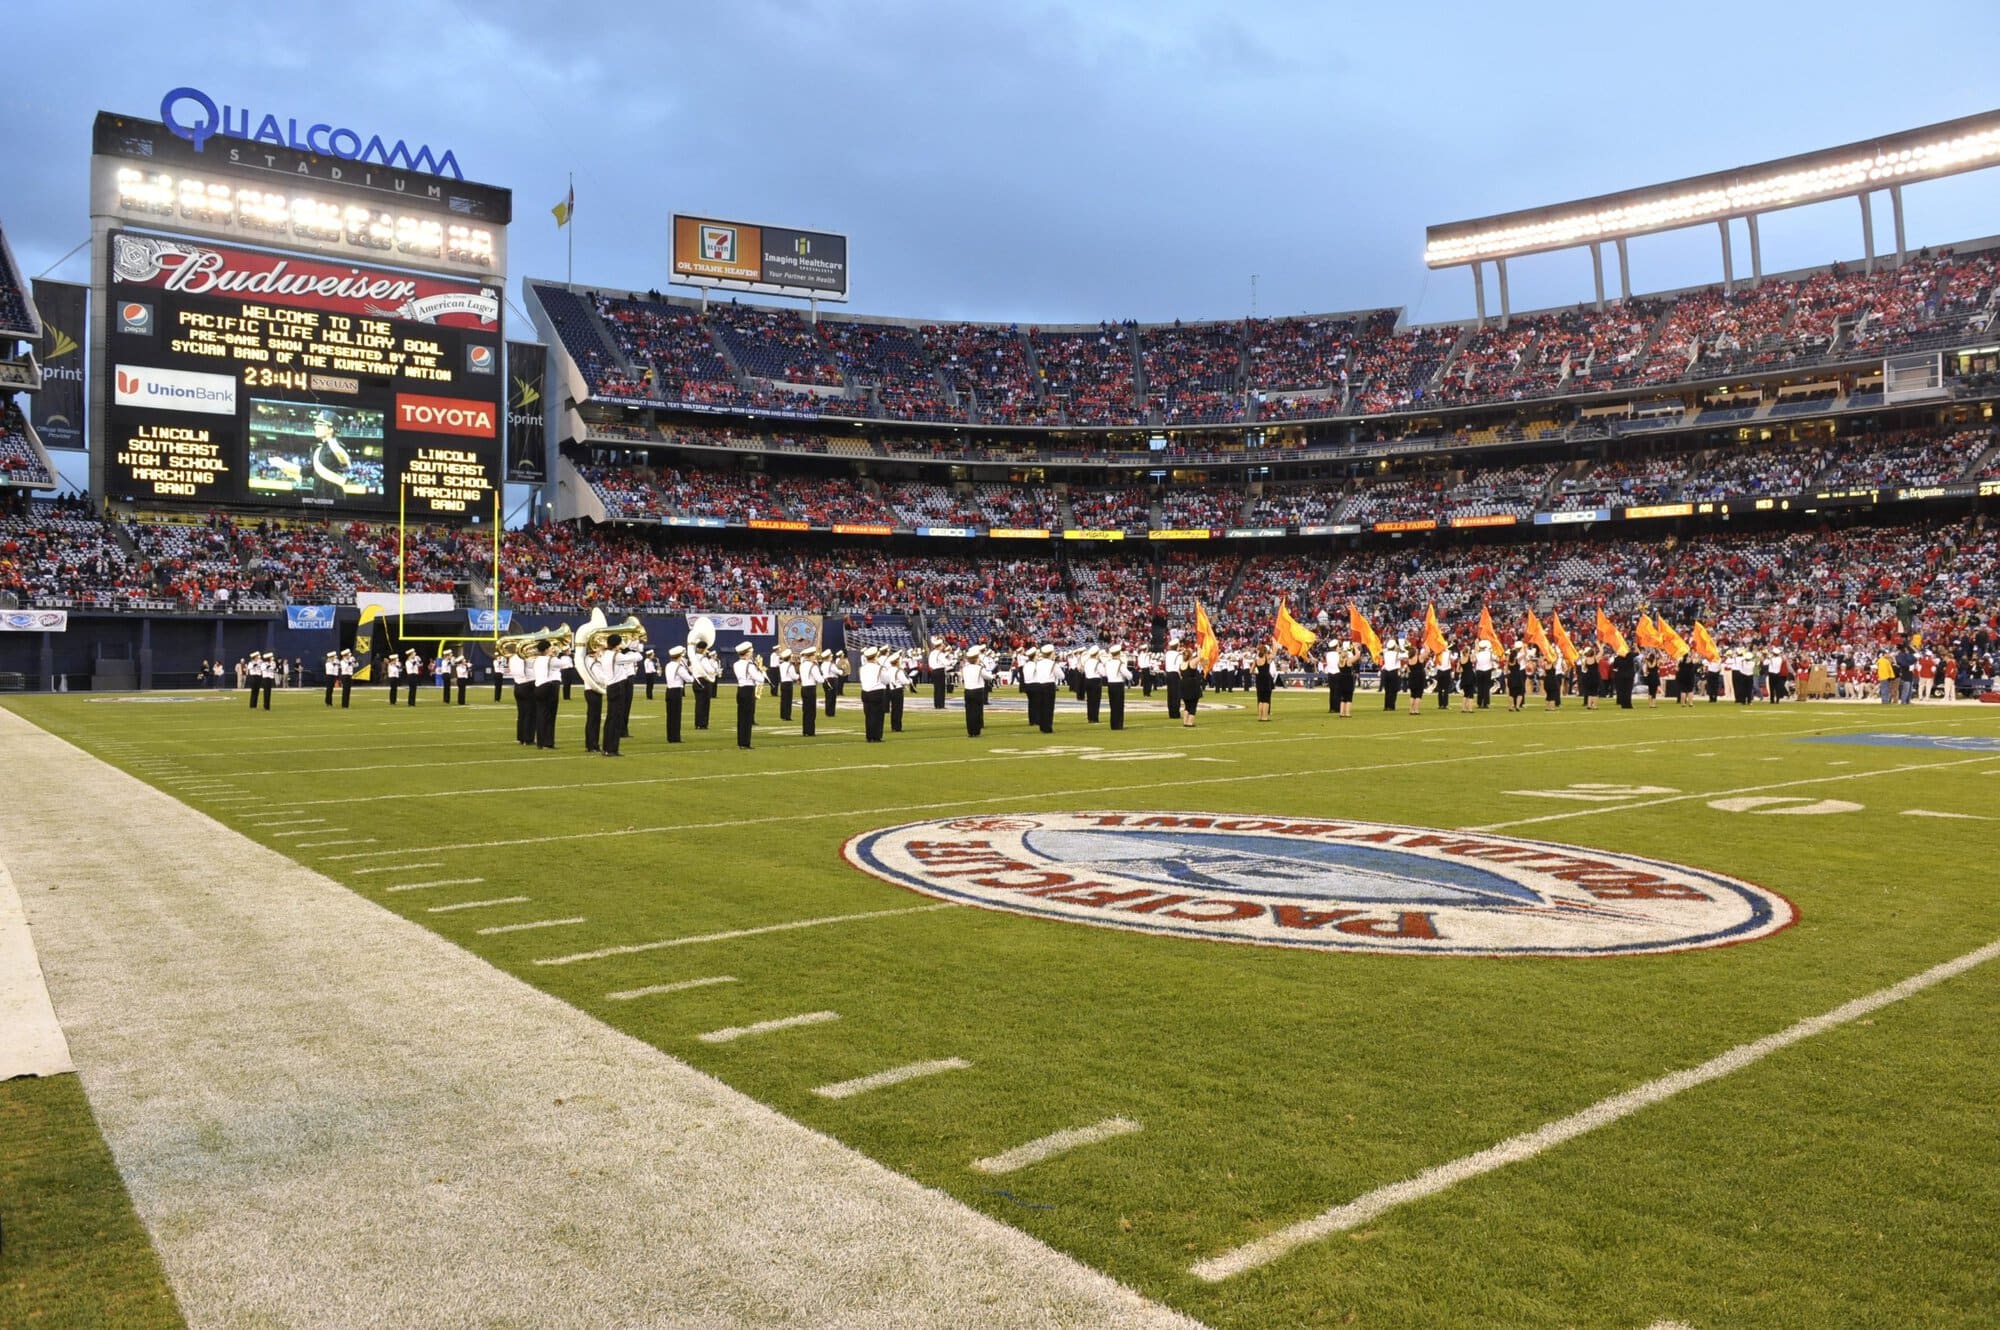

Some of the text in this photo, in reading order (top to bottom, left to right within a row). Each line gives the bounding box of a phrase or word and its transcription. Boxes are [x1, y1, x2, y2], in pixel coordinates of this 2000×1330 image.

[160, 87, 464, 181] QUALCOMM
[229, 148, 441, 198] STADIUM
[693, 263, 724, 273] THANK
[764, 252, 843, 270] Imaging Healthcare
[152, 252, 416, 301] Budweiser
[769, 270, 783, 278] Your
[419, 299, 497, 316] American Lager
[242, 304, 391, 335] WELCOME TO THE
[179, 311, 444, 356] PACIFIC LIFE HOLIDAY BOWL
[189, 329, 436, 367] PRE-GAME SHOW PRESENTED BY THE
[171, 340, 226, 357] SYCUAN
[233, 347, 269, 361] BAND
[276, 352, 293, 364] OF
[302, 354, 326, 368] THE
[404, 366, 452, 382] NATION
[244, 366, 307, 390] 23:44
[312, 377, 358, 391] SYCUAN
[402, 404, 491, 429] TOYOTA
[508, 412, 544, 427] Sprint
[138, 425, 209, 442] LINCOLN
[128, 439, 219, 456] SOUTHEAST
[418, 448, 476, 463] LINCOLN
[118, 452, 229, 471] HIGH SCHOOL
[409, 460, 485, 476] SOUTHEAST
[132, 467, 214, 484] MARCHING
[401, 472, 493, 489] HIGH SCHOOL
[154, 482, 196, 495] BAND
[413, 486, 481, 501] MARCHING
[430, 499, 465, 511] BAND
[751, 520, 808, 530] WELLS FARGO
[1551, 511, 1596, 522] GEICO
[1376, 520, 1435, 531] WELLS FARGO
[750, 616, 768, 634] N
[1072, 813, 1716, 902] HOLIDAY BOWL
[968, 871, 1448, 941] PACIFIC
